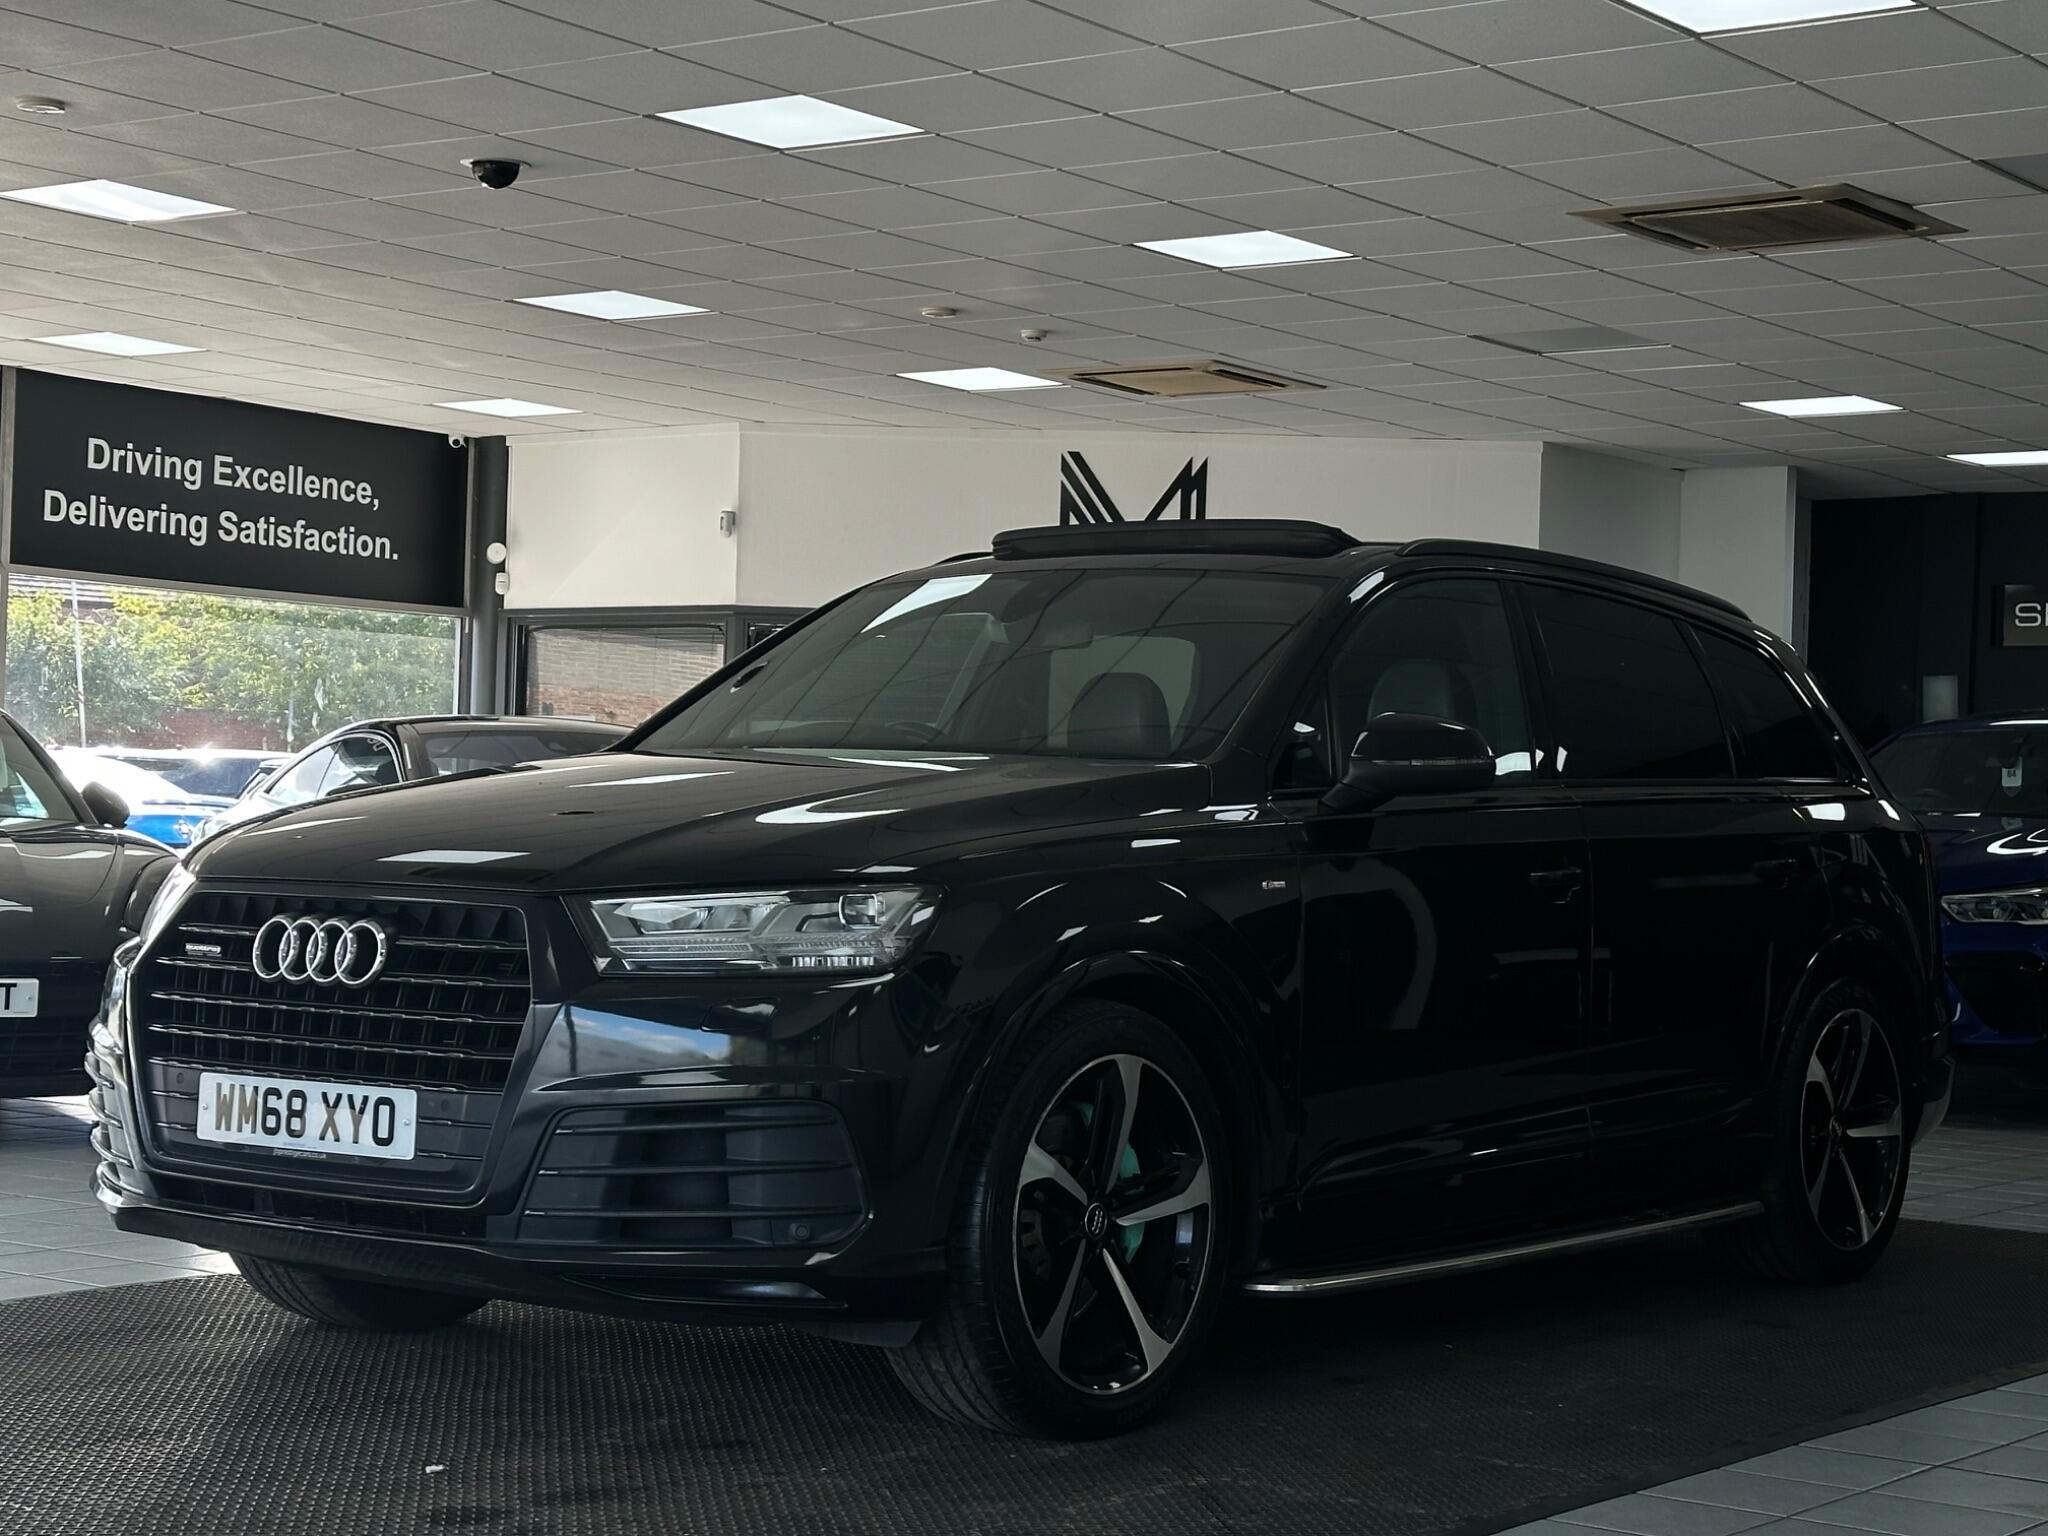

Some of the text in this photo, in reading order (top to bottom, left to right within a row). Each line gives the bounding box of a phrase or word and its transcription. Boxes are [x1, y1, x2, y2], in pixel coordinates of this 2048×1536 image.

[87, 437, 380, 511] Driving Excellence,
[43, 489, 399, 561] Delivering Satisfaction.
[214, 1081, 396, 1147] WM68 XYO
